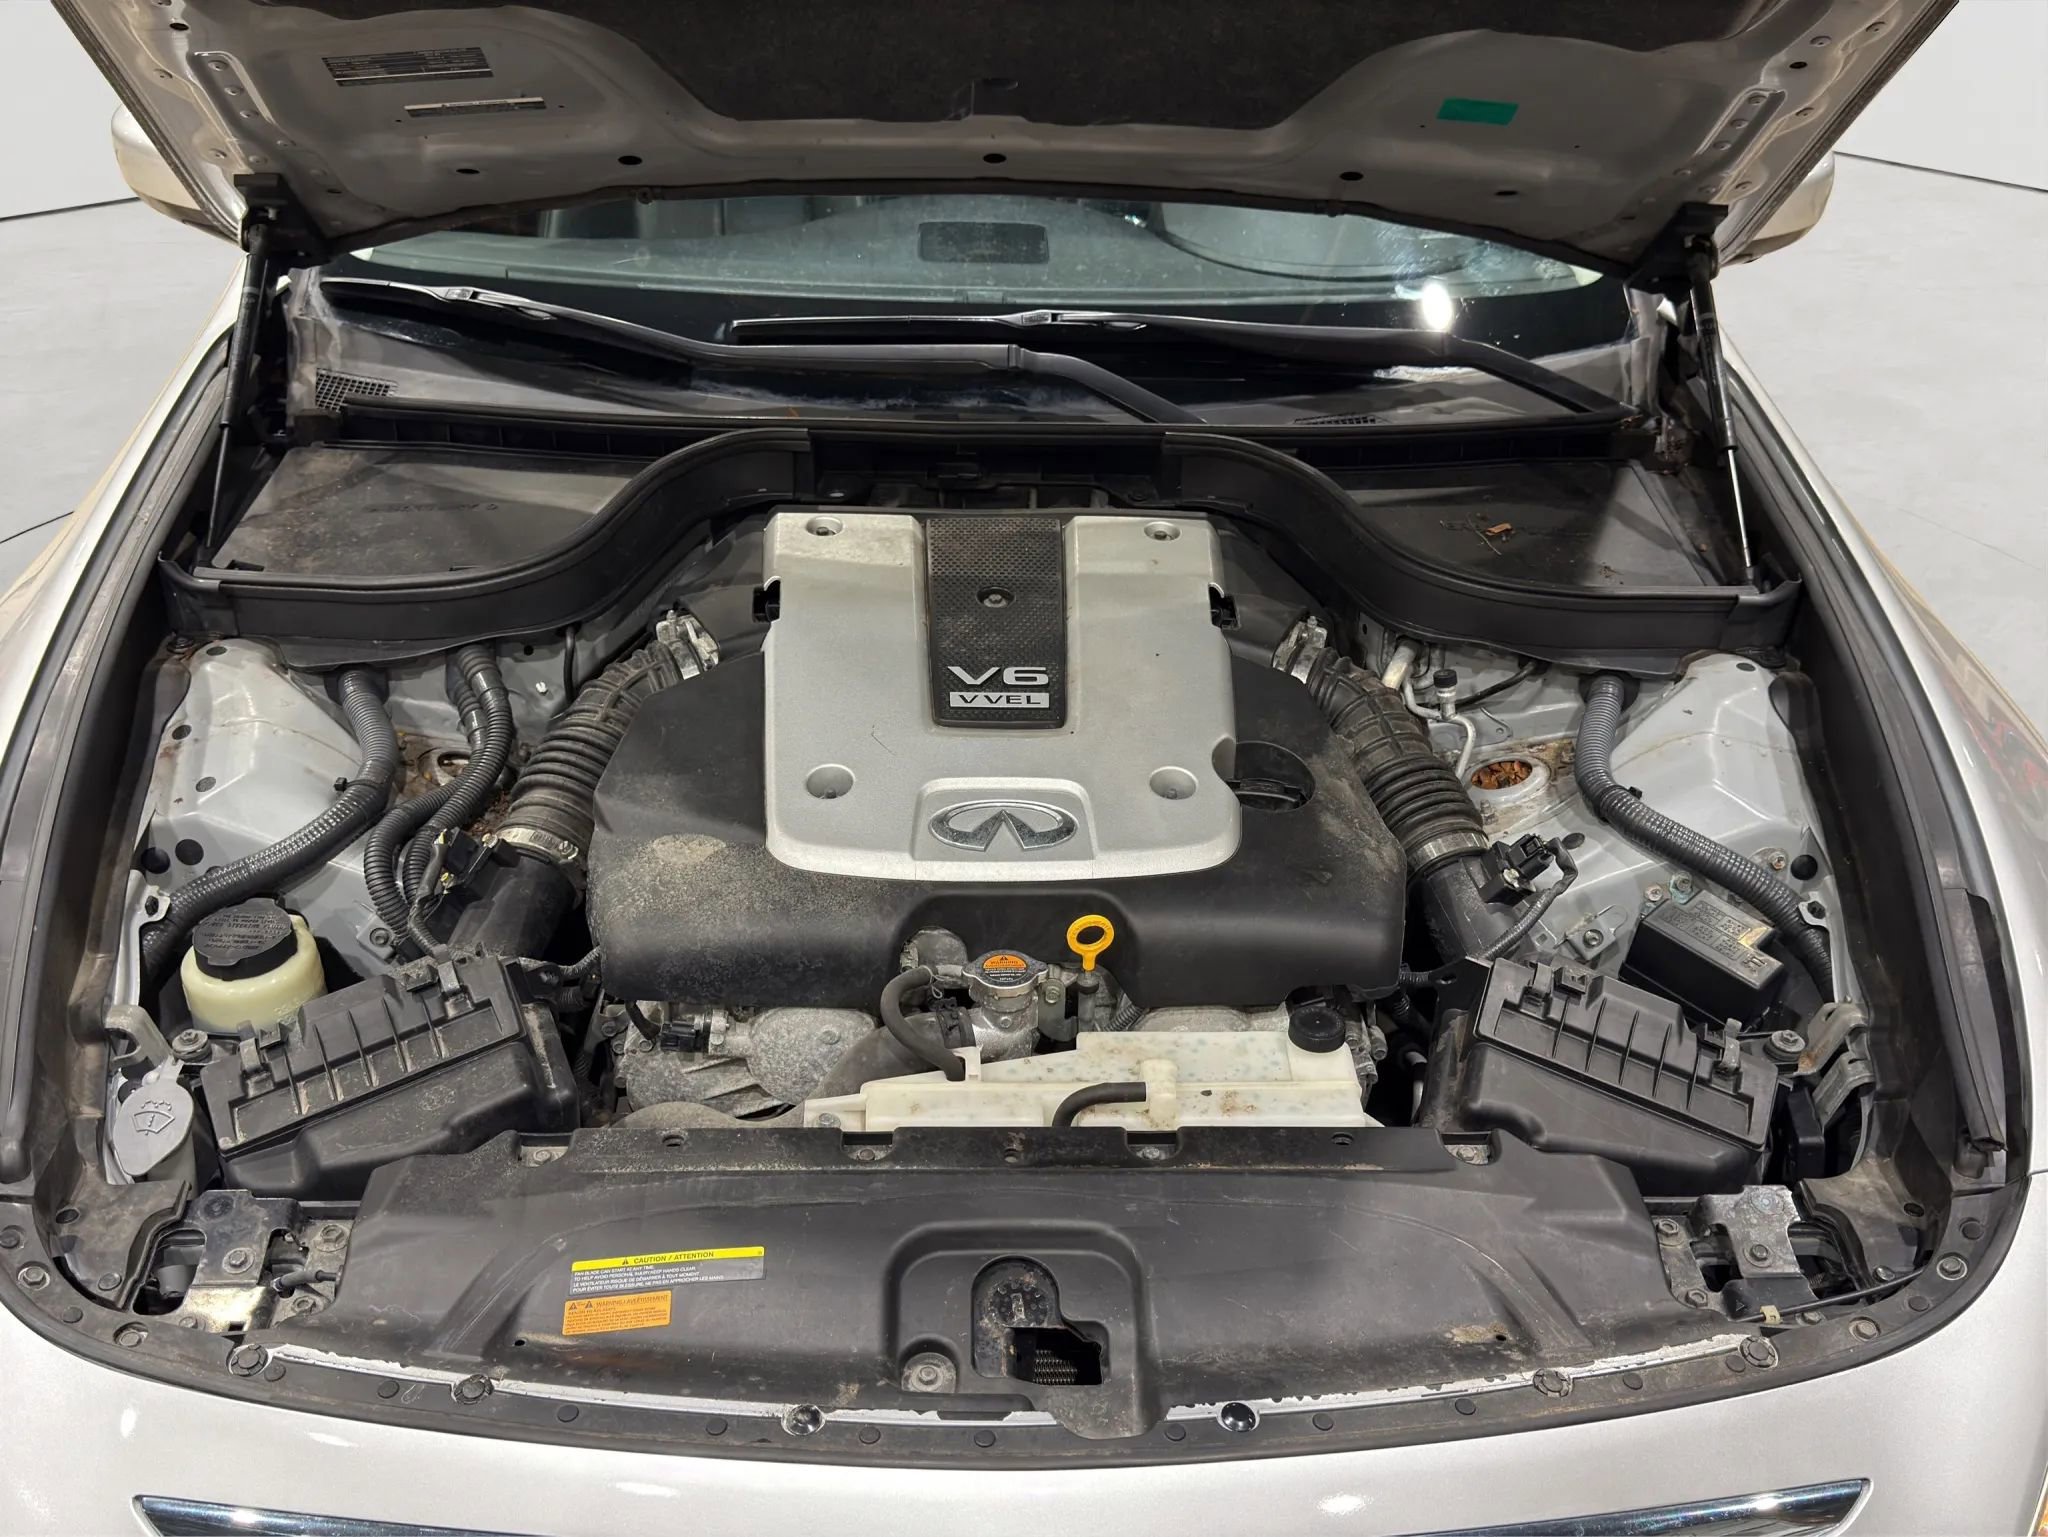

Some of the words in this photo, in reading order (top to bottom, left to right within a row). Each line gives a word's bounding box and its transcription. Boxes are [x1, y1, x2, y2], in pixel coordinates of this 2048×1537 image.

[947, 666, 1049, 686] V6
[959, 694, 1041, 705] VVEL
[634, 1255, 666, 1263] CAUTION
[674, 1252, 714, 1260] ATTENTION
